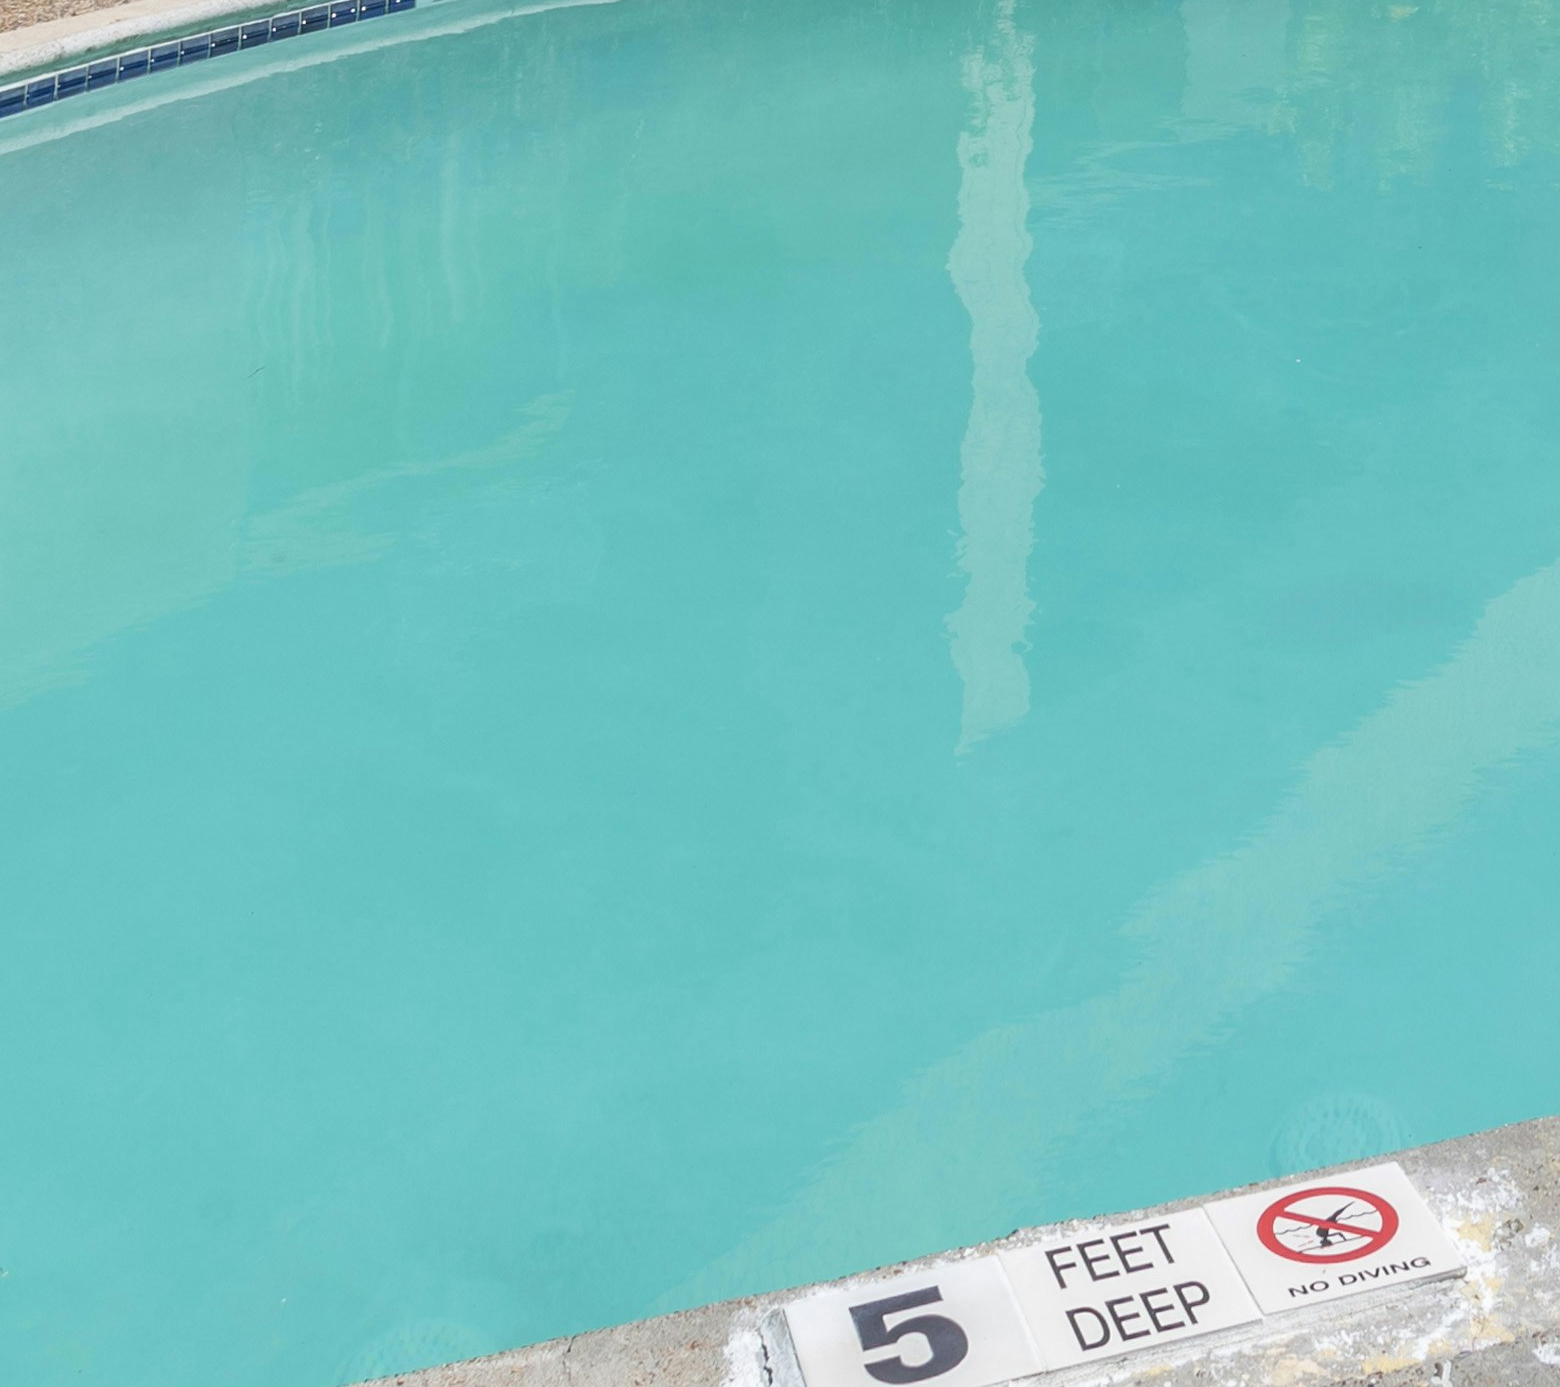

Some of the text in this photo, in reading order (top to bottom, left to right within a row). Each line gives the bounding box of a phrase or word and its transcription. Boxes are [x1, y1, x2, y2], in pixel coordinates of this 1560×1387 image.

[1043, 1223, 1176, 1290] FEET
[1287, 1256, 1433, 1298] NO DIVING
[848, 1285, 970, 1385] 5
[1065, 1280, 1211, 1352] DEEP
